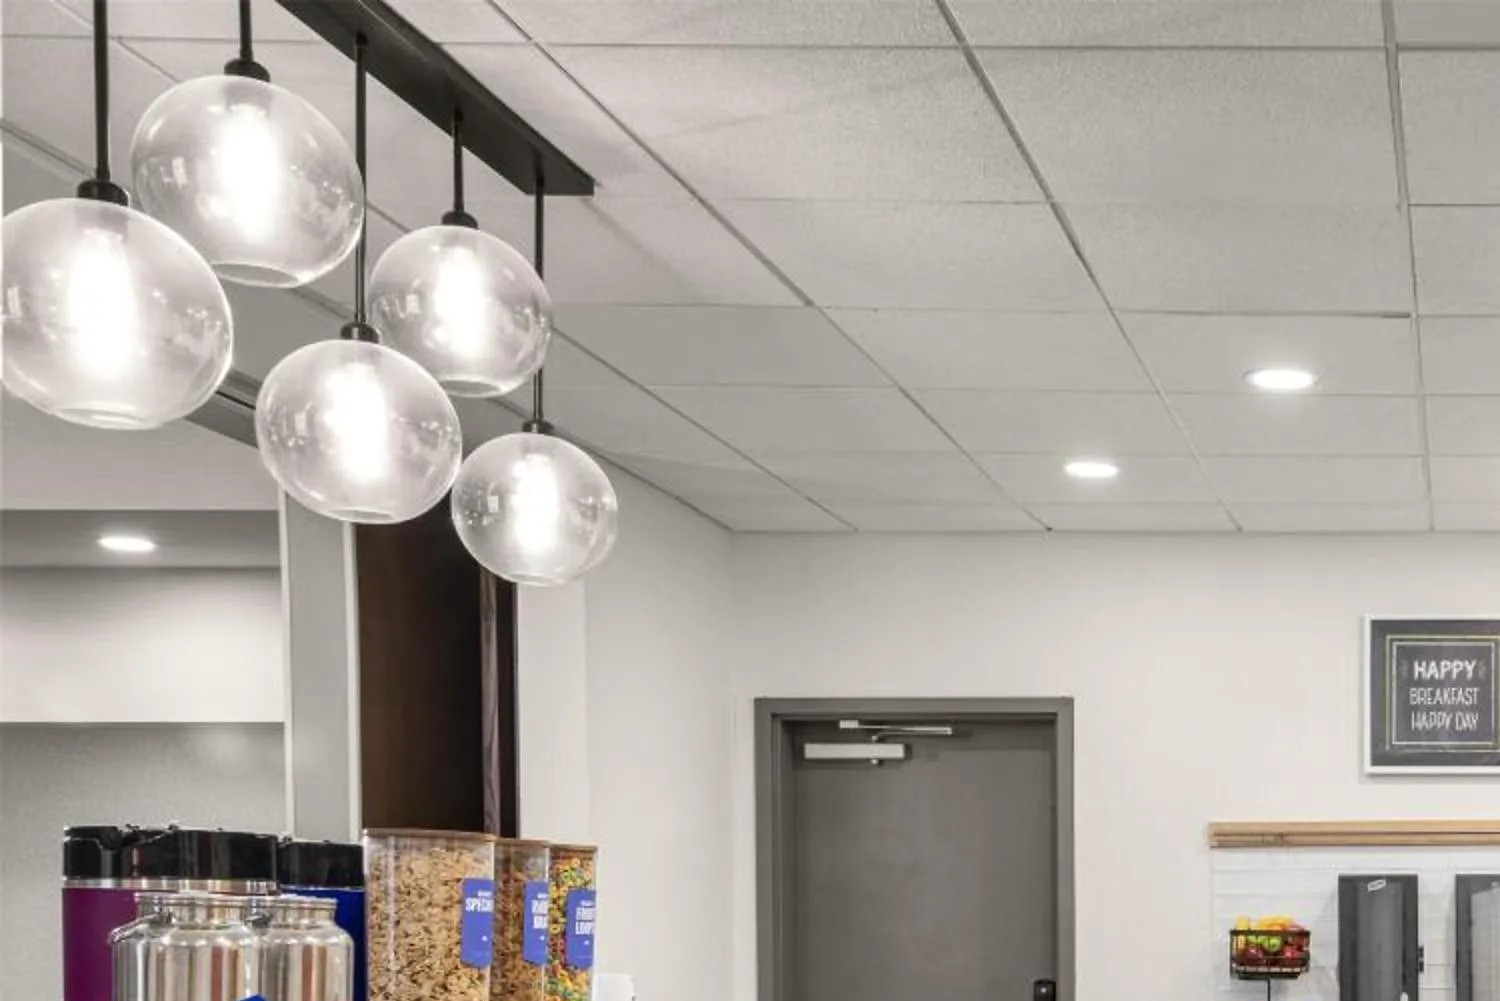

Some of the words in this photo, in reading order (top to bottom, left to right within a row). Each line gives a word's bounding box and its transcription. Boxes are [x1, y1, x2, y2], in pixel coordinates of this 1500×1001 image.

[1413, 659, 1477, 681] HAPPY
[1409, 687, 1480, 705] BREAKFAST
[1411, 711, 1453, 731] HAPPY
[1455, 711, 1480, 731] DAY
